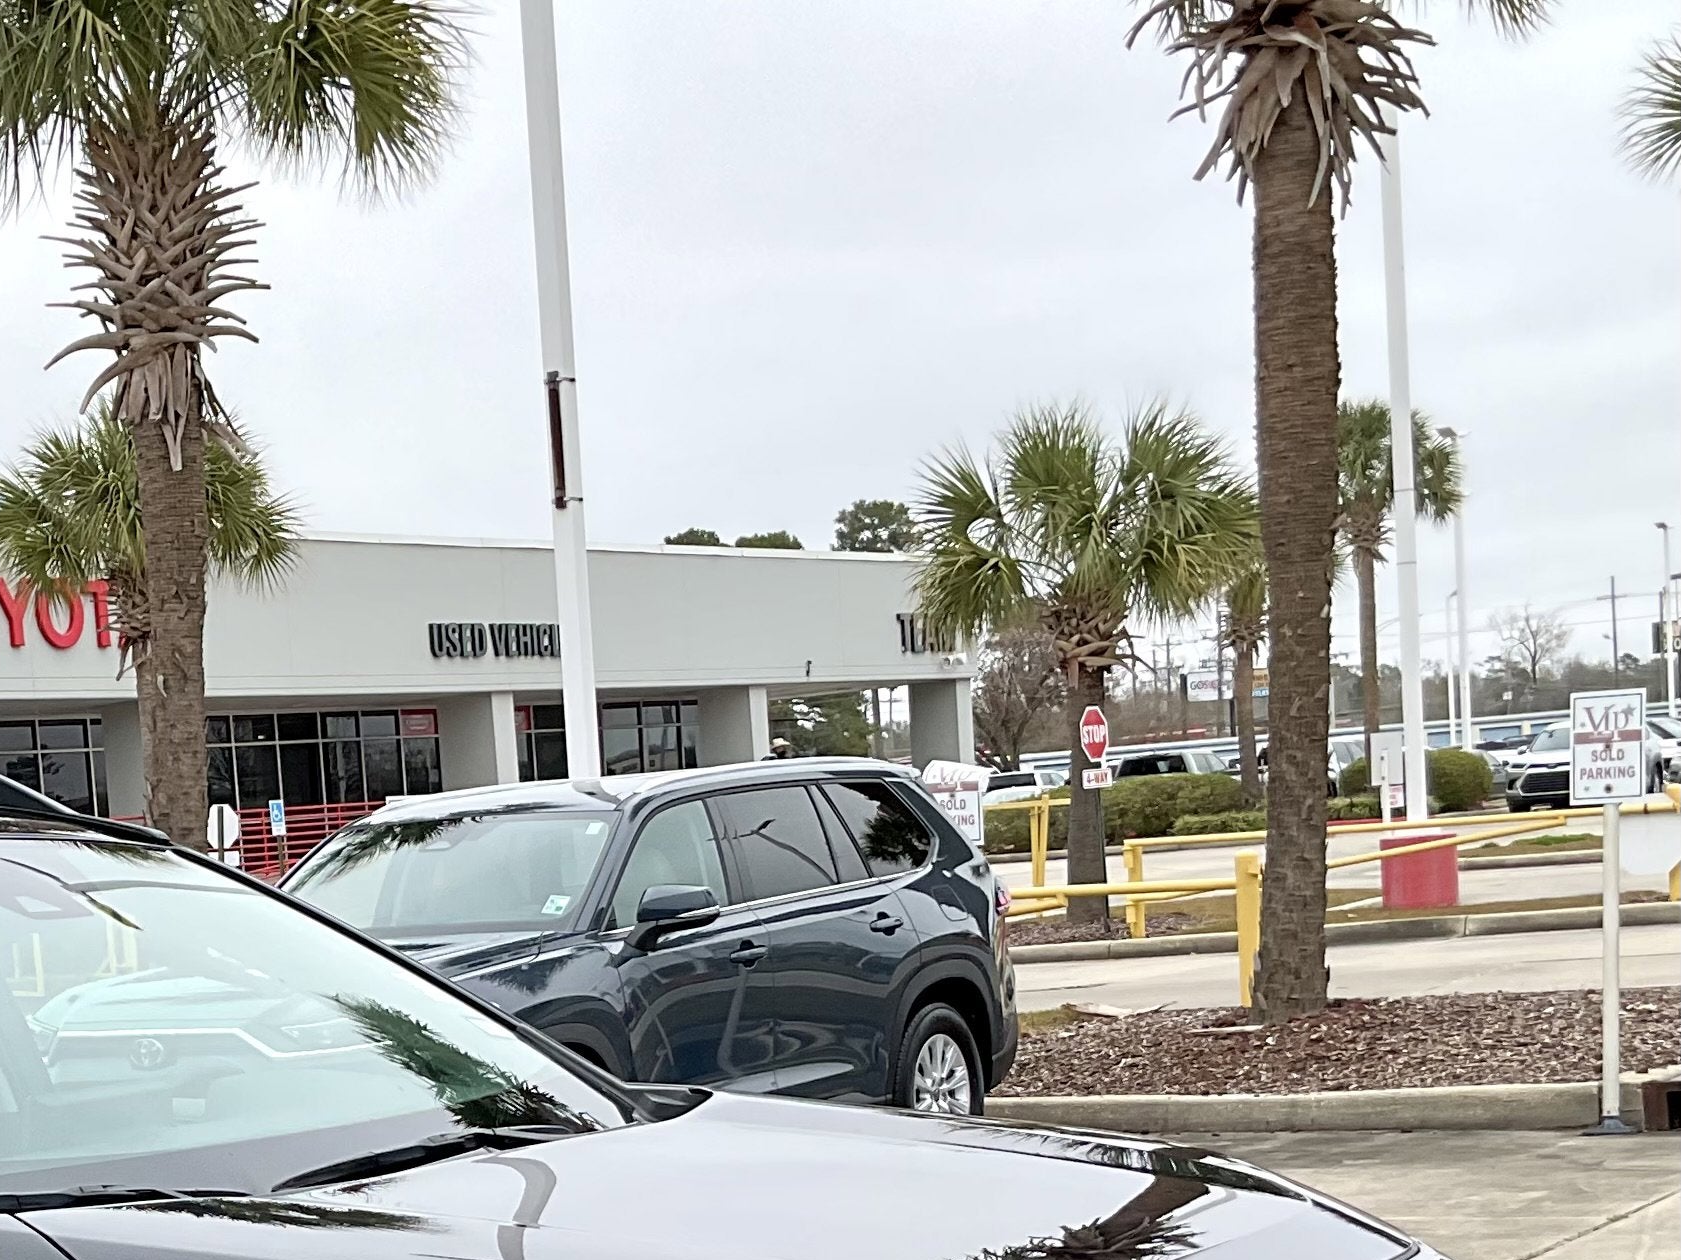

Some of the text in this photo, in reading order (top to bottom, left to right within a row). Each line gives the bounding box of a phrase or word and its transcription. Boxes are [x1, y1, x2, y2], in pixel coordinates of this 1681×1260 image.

[428, 623, 561, 657] USED VEHICL
[1082, 724, 1106, 744] STOP
[1591, 748, 1625, 762] SOLD
[1086, 772, 1108, 784] 4-WAY
[1580, 766, 1636, 780] PARKING
